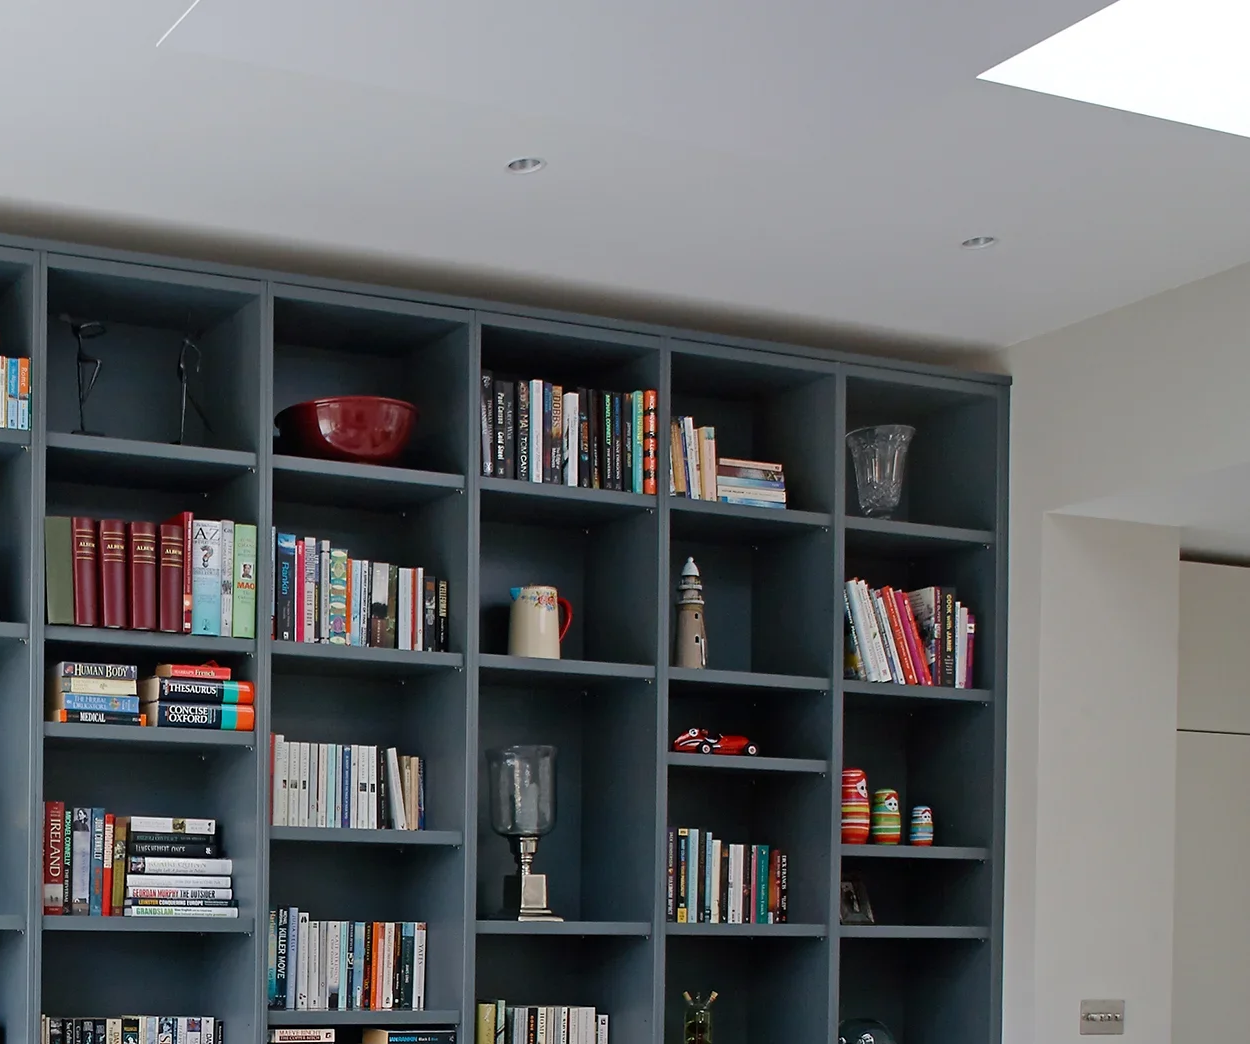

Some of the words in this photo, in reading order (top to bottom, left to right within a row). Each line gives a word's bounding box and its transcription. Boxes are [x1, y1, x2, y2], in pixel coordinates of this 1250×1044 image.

[20, 366, 28, 388] Rome
[497, 393, 505, 405] Paul
[552, 395, 561, 428] DOBBS
[497, 431, 505, 444] Cold
[497, 444, 506, 460] Steel
[165, 548, 183, 556] ALBUM
[281, 562, 290, 595] Rankin
[237, 582, 256, 590] MAO
[74, 664, 104, 676] HUMAN
[105, 665, 129, 678] BODY
[195, 669, 215, 677] French
[170, 684, 217, 695] THESAURUS
[80, 712, 106, 722] MEDICAL
[169, 705, 208, 715] CONCISE
[169, 714, 208, 724] OXFORD
[95, 817, 103, 832] JOHN
[49, 818, 62, 878] IRELAND
[94, 833, 104, 861] CONNOLLY
[277, 928, 287, 954] KILLER
[277, 955, 286, 980] MOVE
